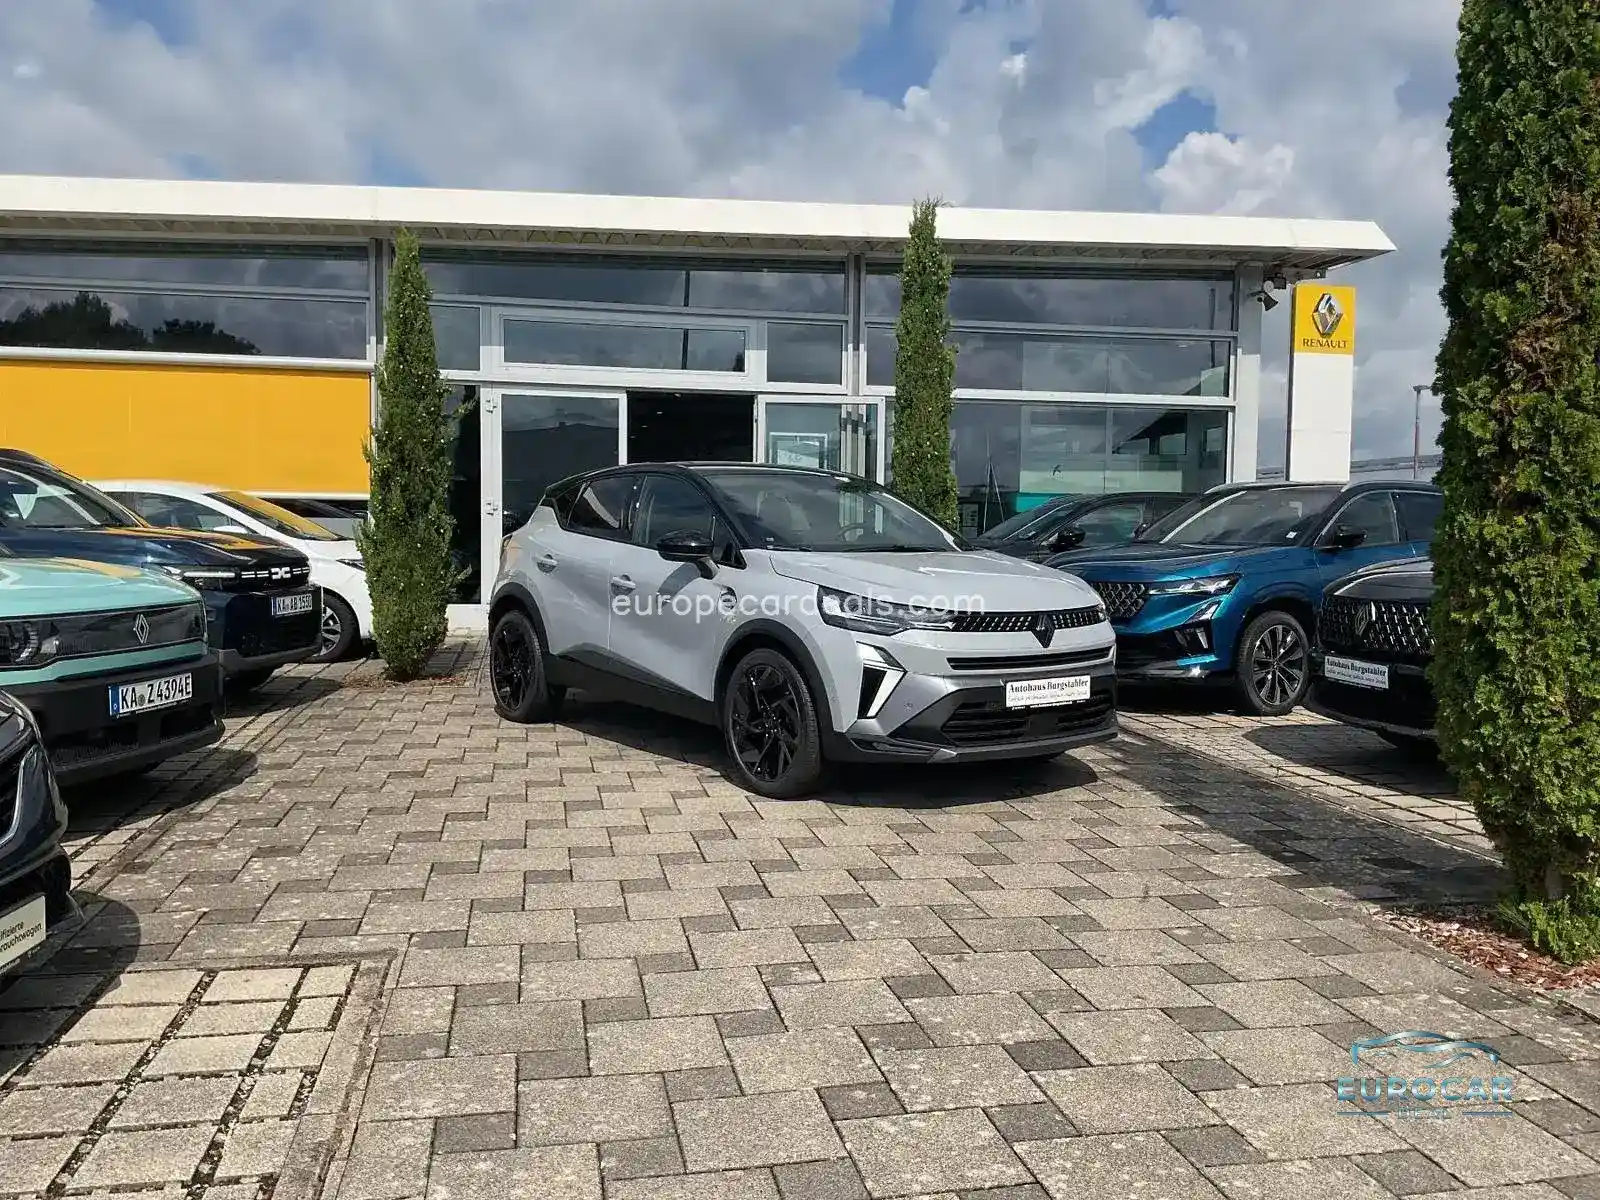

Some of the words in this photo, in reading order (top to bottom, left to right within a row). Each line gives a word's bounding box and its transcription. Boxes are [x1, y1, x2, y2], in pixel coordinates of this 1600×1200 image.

[1302, 338, 1347, 349] RENAULT
[1009, 683, 1046, 693] Autohaus
[1047, 678, 1089, 691] Burgstahler
[120, 686, 138, 710] KA
